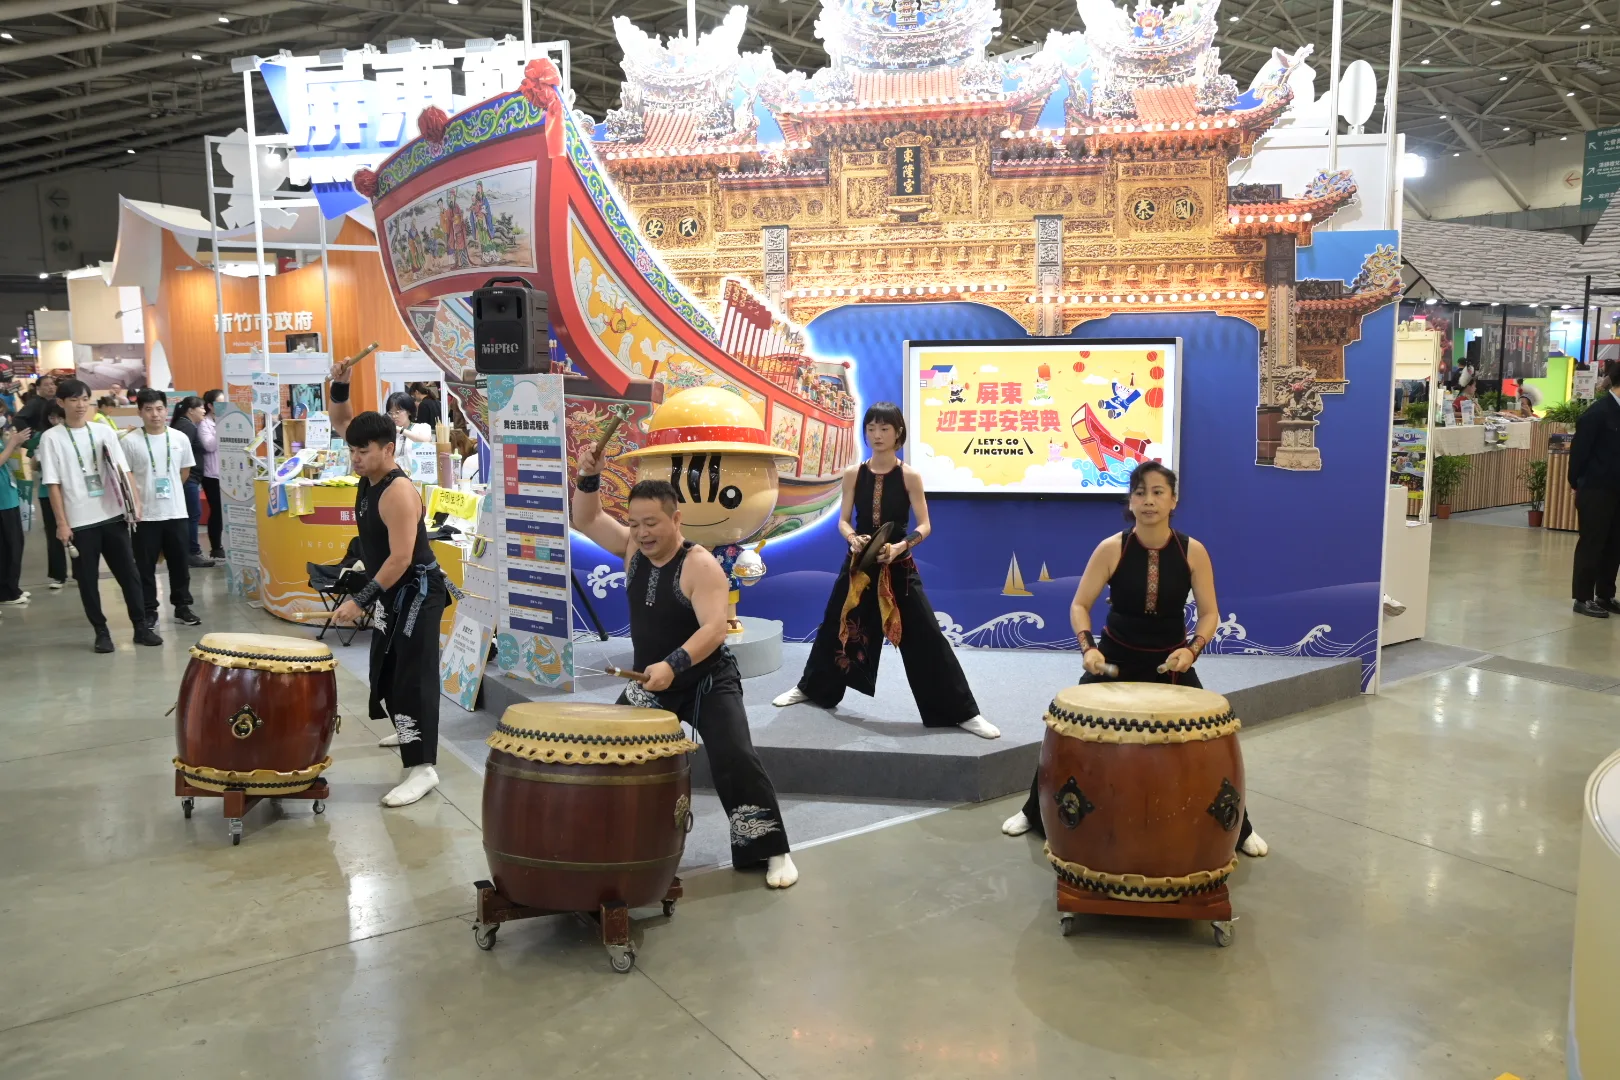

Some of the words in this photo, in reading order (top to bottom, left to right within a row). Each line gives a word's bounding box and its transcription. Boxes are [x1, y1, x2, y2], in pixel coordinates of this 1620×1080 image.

[902, 147, 915, 193] 東隆宮
[214, 311, 313, 333] 新竹市政府
[976, 381, 1023, 405] 屏東
[503, 419, 549, 431] 舞台活動流程表
[935, 409, 1062, 432] 迎王平安祭典
